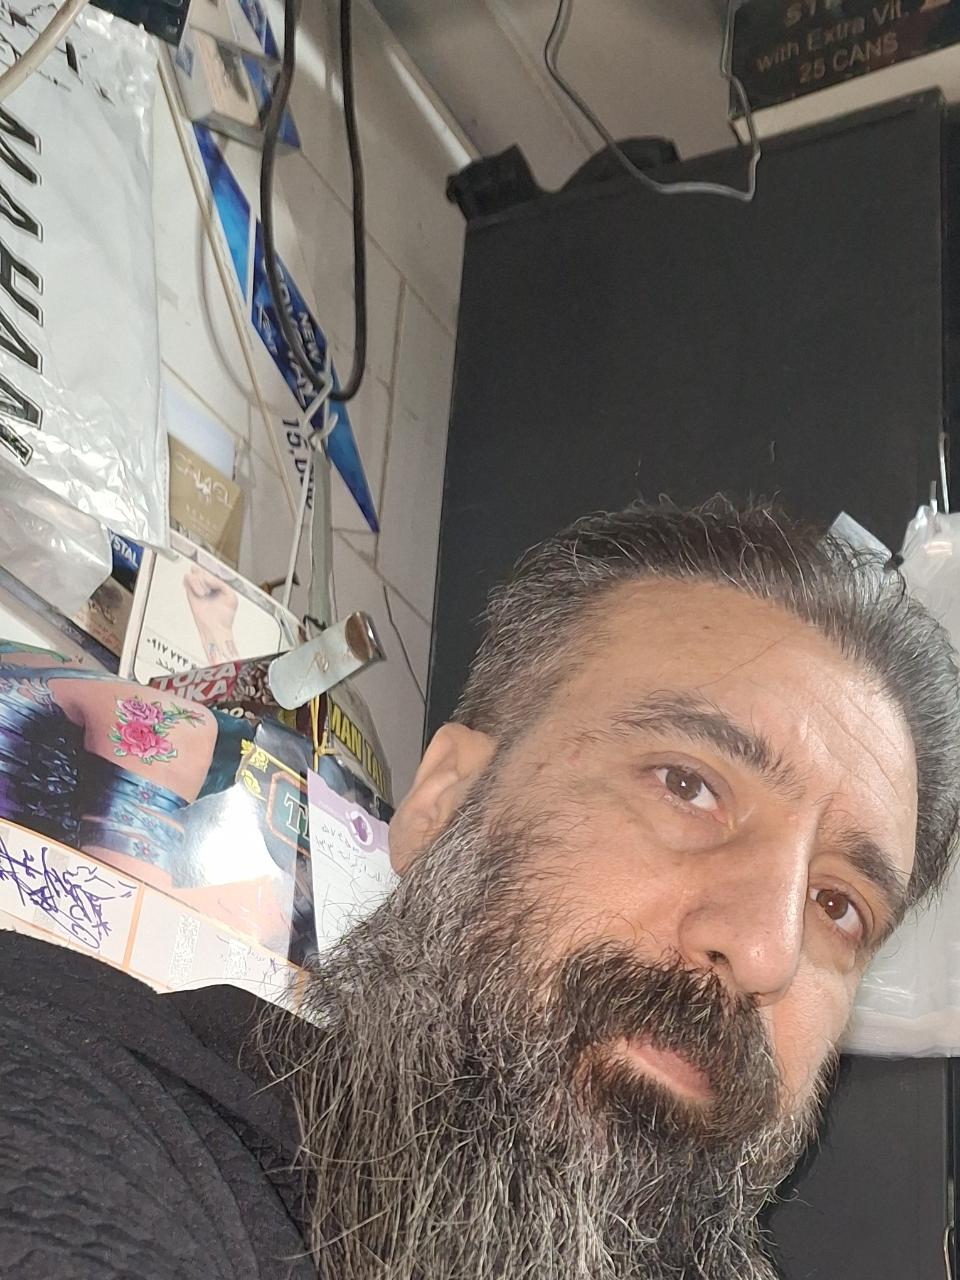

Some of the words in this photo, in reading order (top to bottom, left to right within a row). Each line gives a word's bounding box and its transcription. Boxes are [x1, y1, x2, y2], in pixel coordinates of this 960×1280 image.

[756, 40, 800, 73] with
[805, 16, 866, 50] Extra
[799, 61, 826, 84] 25
[832, 32, 899, 73] CANS
[298, 311, 322, 364] NEW
[108, 532, 139, 569] YSTAL
[173, 679, 229, 701] IKA
